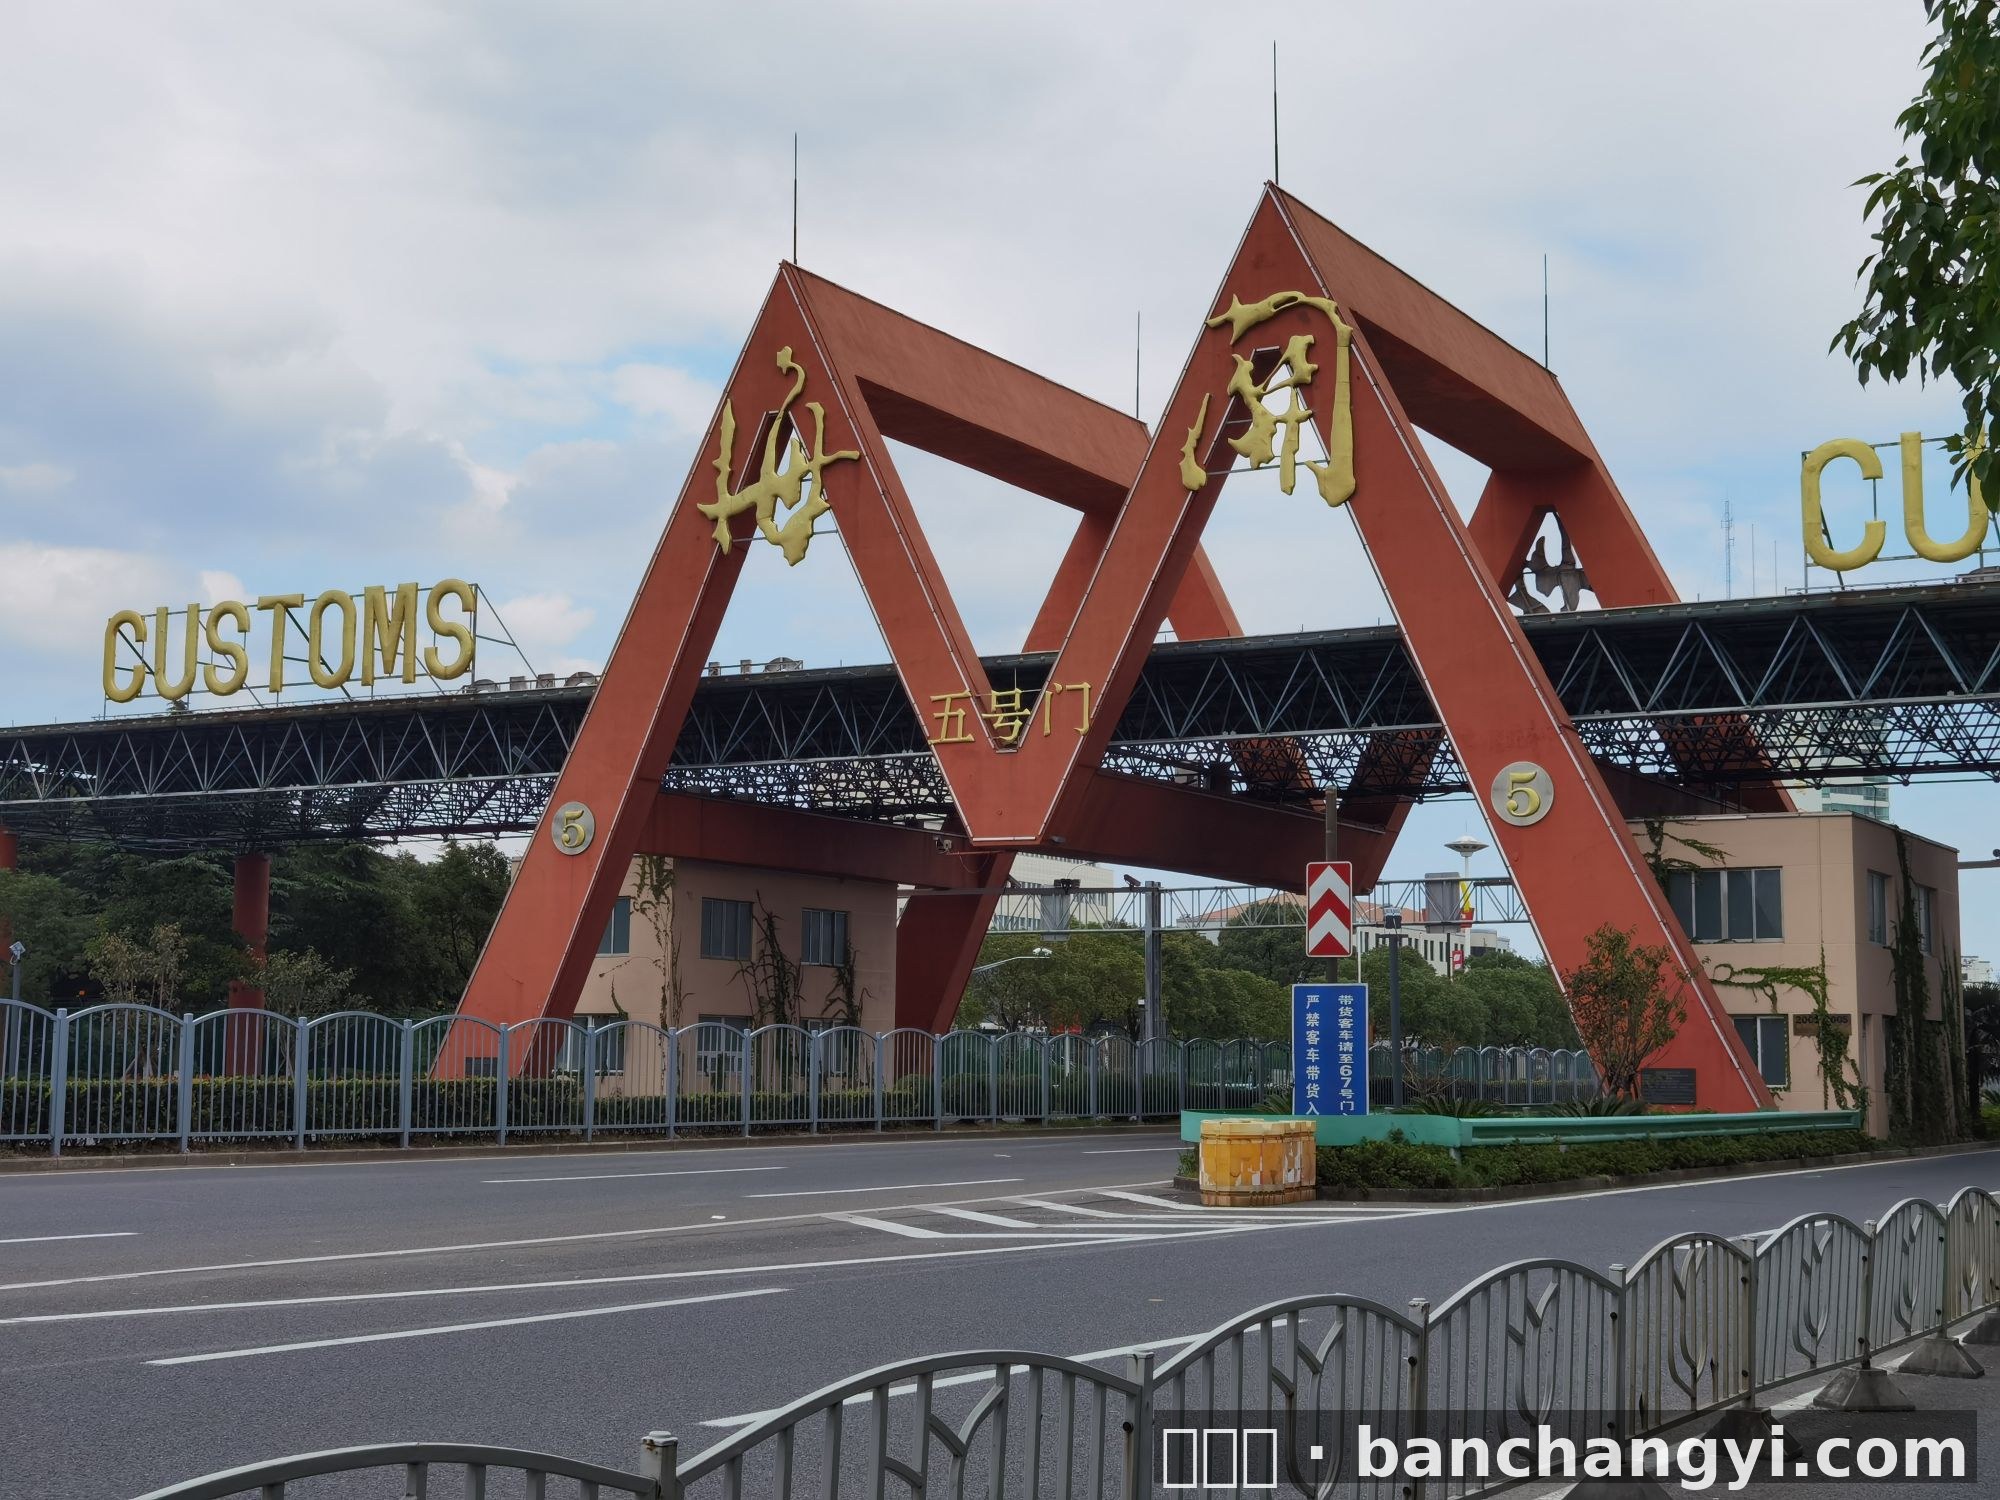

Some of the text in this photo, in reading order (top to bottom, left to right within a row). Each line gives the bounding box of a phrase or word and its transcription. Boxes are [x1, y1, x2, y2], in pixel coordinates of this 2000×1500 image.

[103, 578, 475, 703] CUSTOMS
[927, 681, 1092, 746] 五号门
[562, 810, 585, 848] 5
[1506, 771, 1540, 817] 5
[1305, 994, 1320, 1115] 严禁客车带货入
[1338, 994, 1354, 1116] 带货客车请至67号门
